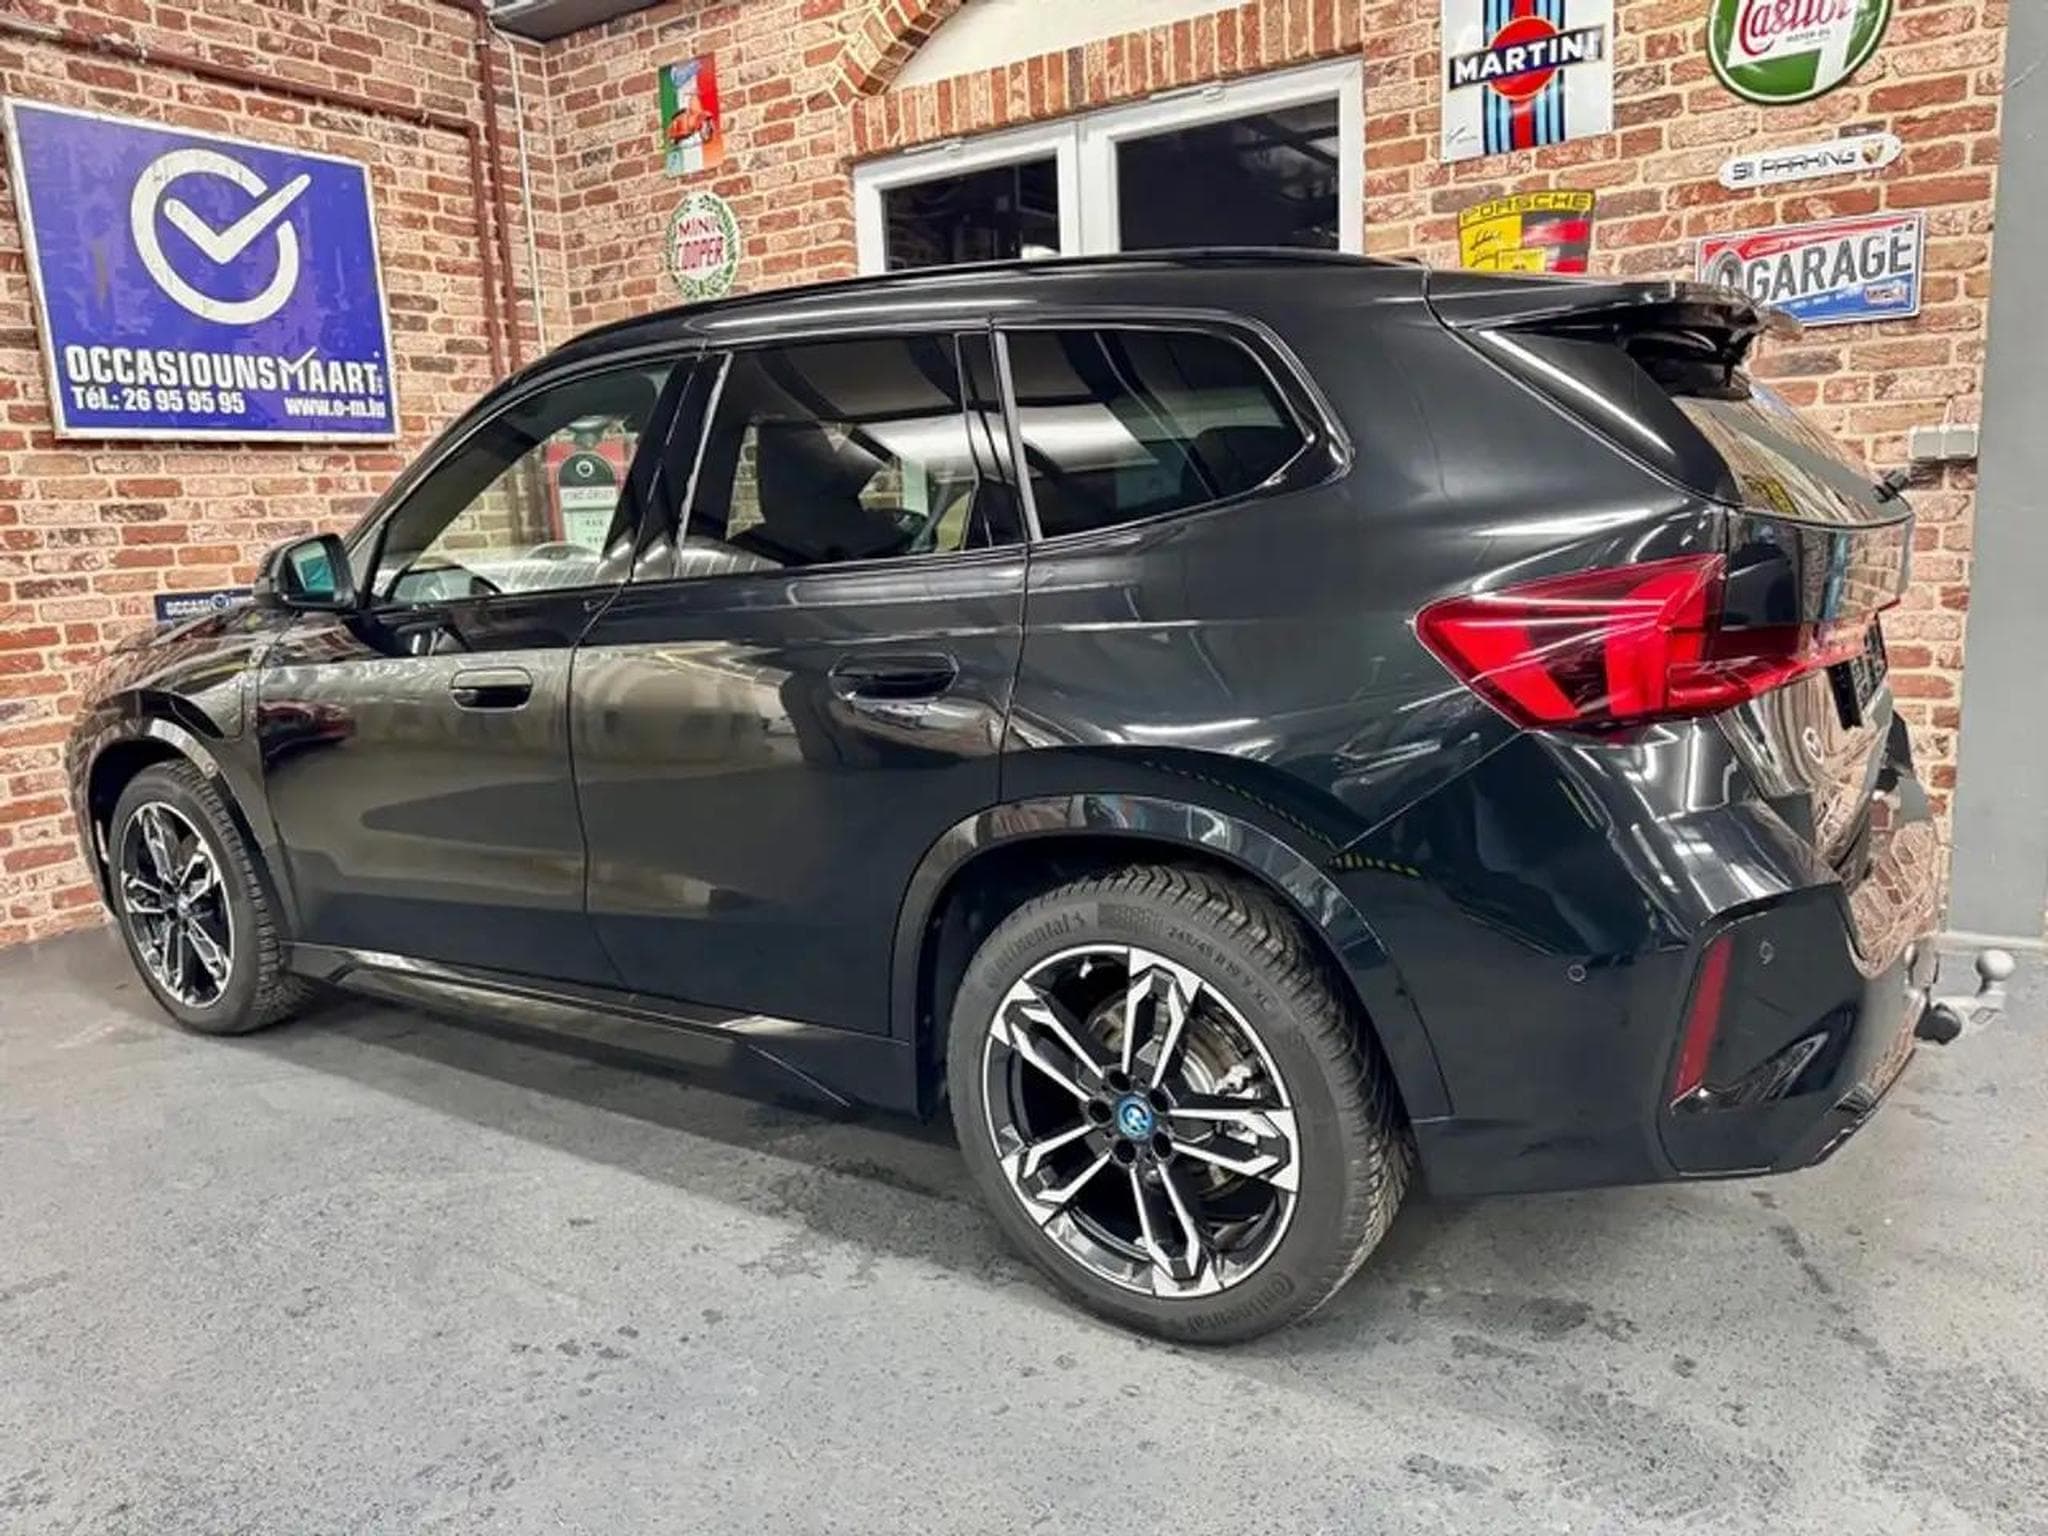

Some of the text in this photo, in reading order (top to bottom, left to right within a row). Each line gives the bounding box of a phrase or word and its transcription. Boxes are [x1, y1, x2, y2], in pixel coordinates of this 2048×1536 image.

[1454, 30, 1597, 84] MARTINI
[1462, 193, 1591, 221] PORSCHE
[679, 216, 724, 237] MINI
[1747, 231, 1914, 304] GARAGE
[121, 388, 152, 412] 26
[154, 389, 183, 413] 95
[186, 390, 216, 414] 95
[217, 391, 246, 415] 95
